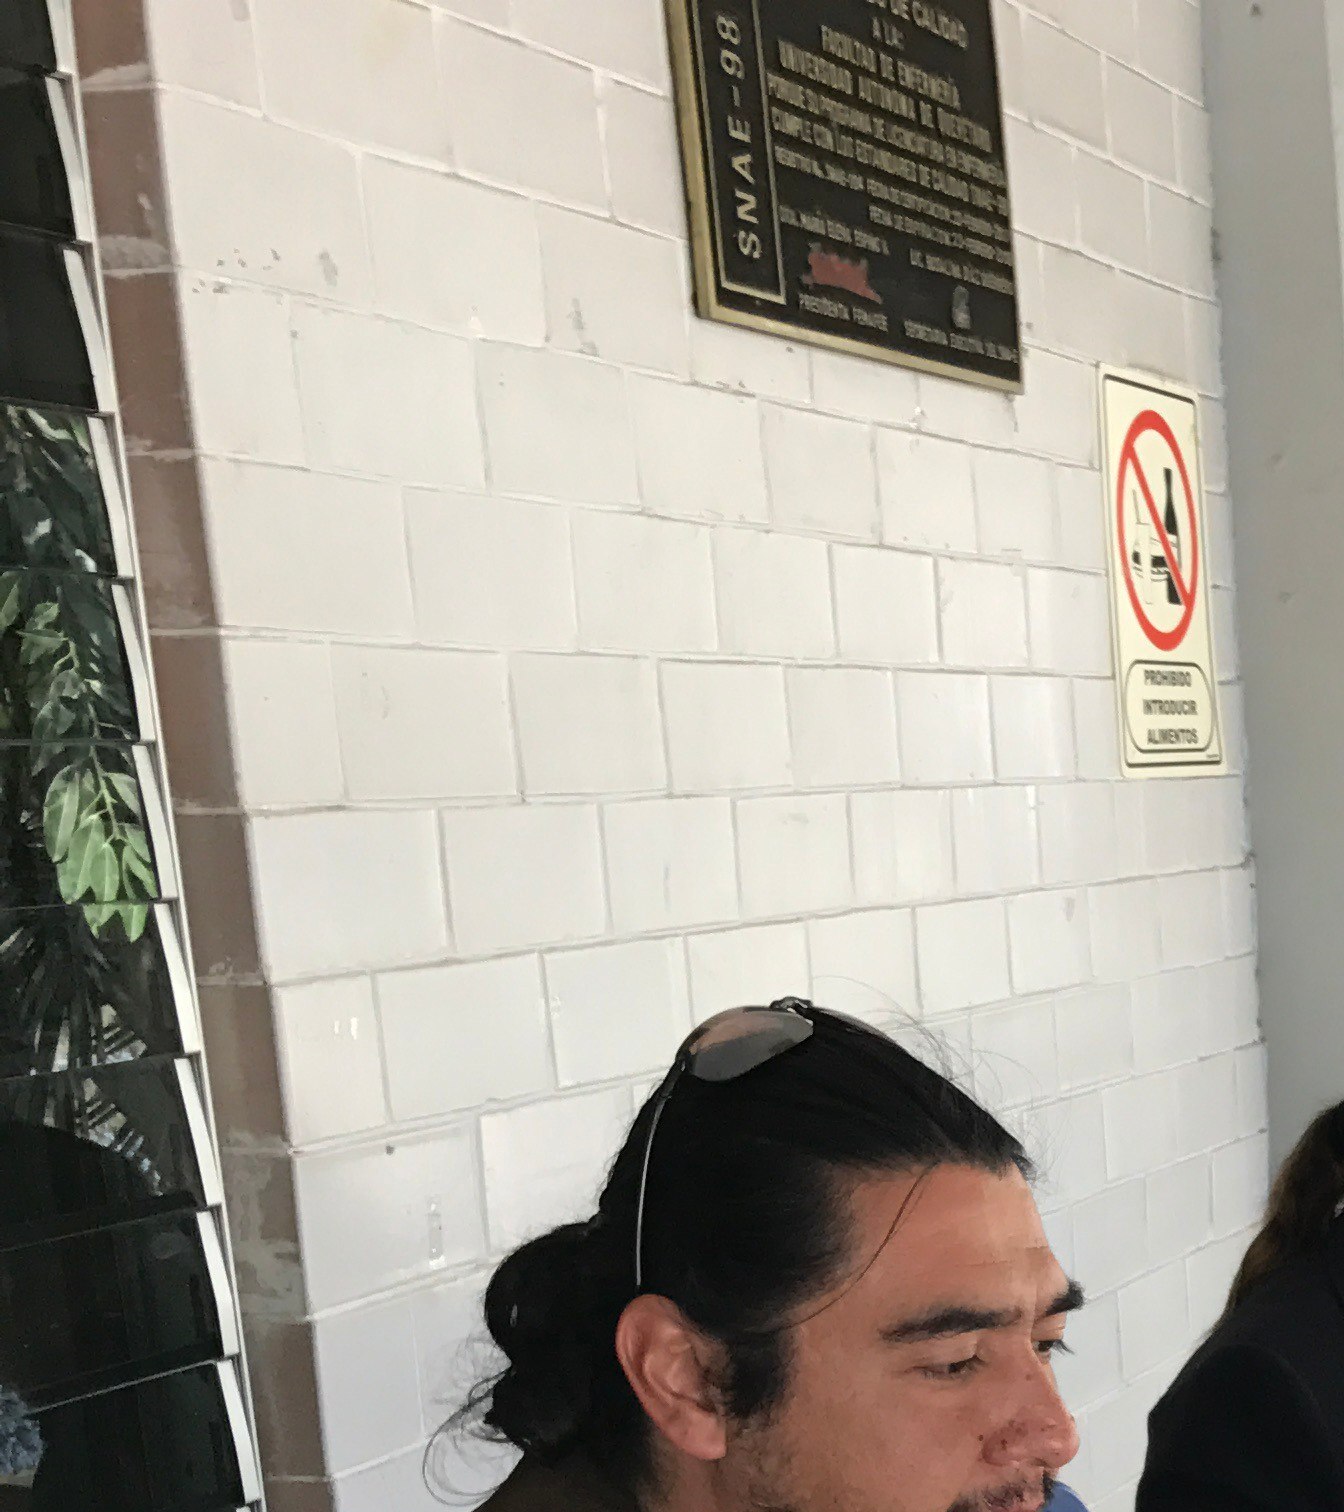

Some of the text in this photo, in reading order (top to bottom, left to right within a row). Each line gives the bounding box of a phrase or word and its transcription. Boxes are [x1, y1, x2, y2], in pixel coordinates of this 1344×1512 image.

[715, 14, 763, 260] SNAE-98
[1144, 670, 1192, 687] PROHIBIDO
[1143, 699, 1197, 715] INTRODUCIR
[1147, 728, 1198, 744] ALIMENTOS
